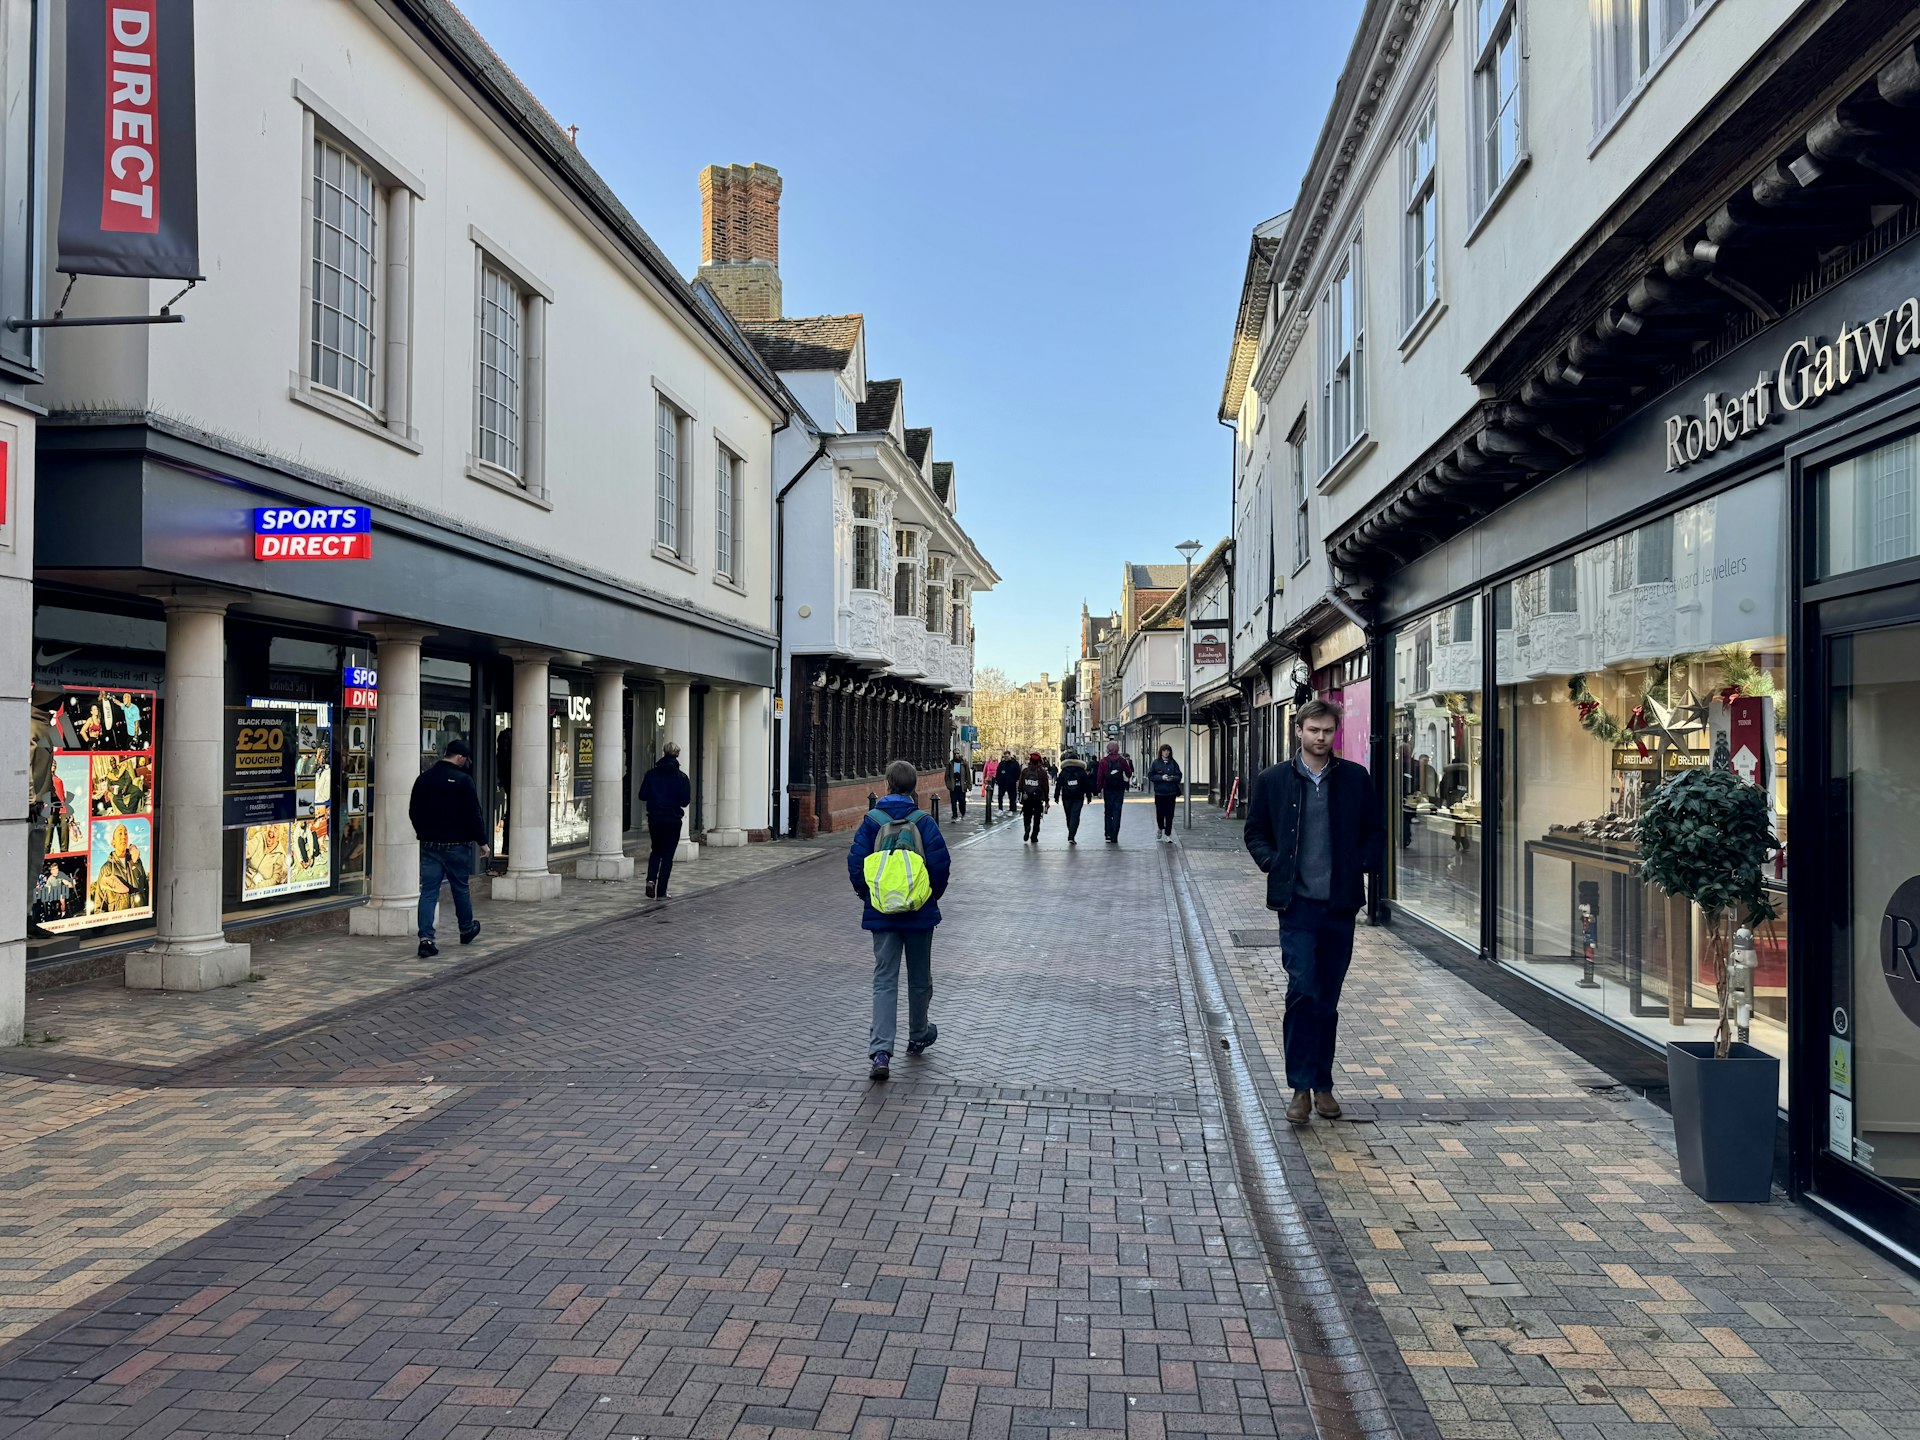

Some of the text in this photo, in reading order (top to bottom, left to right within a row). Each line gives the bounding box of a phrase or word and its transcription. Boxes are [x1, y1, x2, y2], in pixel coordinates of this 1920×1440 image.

[110, 7, 154, 219] DIRECT
[1664, 370, 1774, 474] Robert
[262, 509, 357, 530] SPORTS
[262, 536, 357, 556] DIRECT
[1662, 569, 1699, 596] Gatward
[1701, 557, 1747, 585] Jewellers
[568, 696, 591, 721] USC
[236, 728, 284, 751] £20
[239, 755, 280, 765] VOUCHER
[1623, 755, 1653, 765] BREITLING
